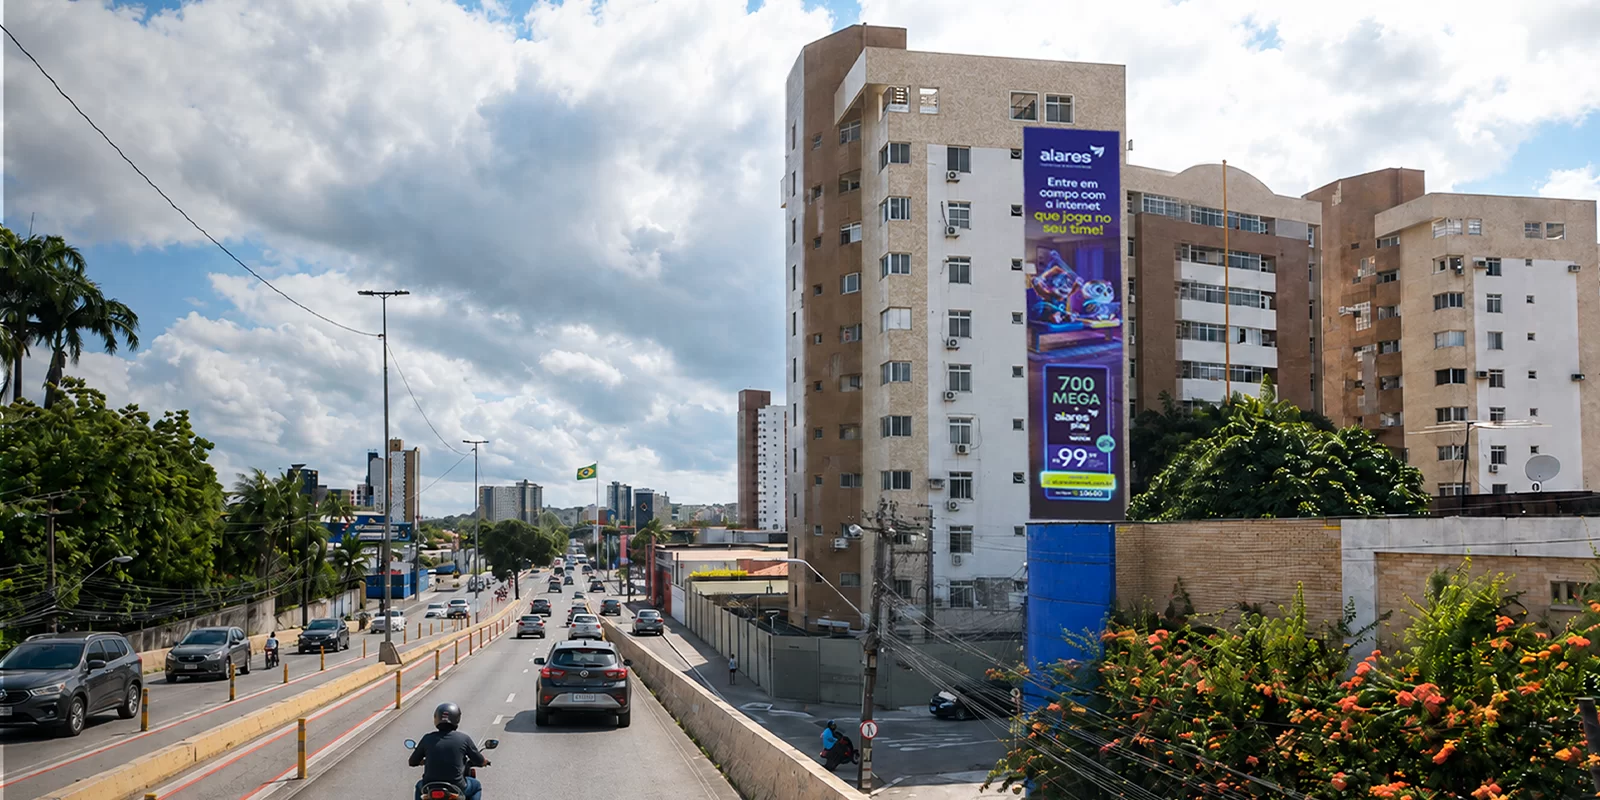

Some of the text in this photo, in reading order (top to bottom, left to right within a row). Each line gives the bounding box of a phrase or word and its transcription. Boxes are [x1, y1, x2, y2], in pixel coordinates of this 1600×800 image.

[1040, 148, 1092, 163] alares
[1047, 177, 1098, 189] Entre em
[1040, 189, 1106, 201] campo com
[1045, 199, 1101, 211] a internet
[1034, 211, 1112, 224] que joga no
[1043, 224, 1104, 236] seu time!
[1058, 376, 1095, 392] 700
[1052, 392, 1100, 405] MEGA
[1054, 411, 1090, 422] alares
[1070, 422, 1090, 431] play
[1058, 448, 1087, 468] 99
